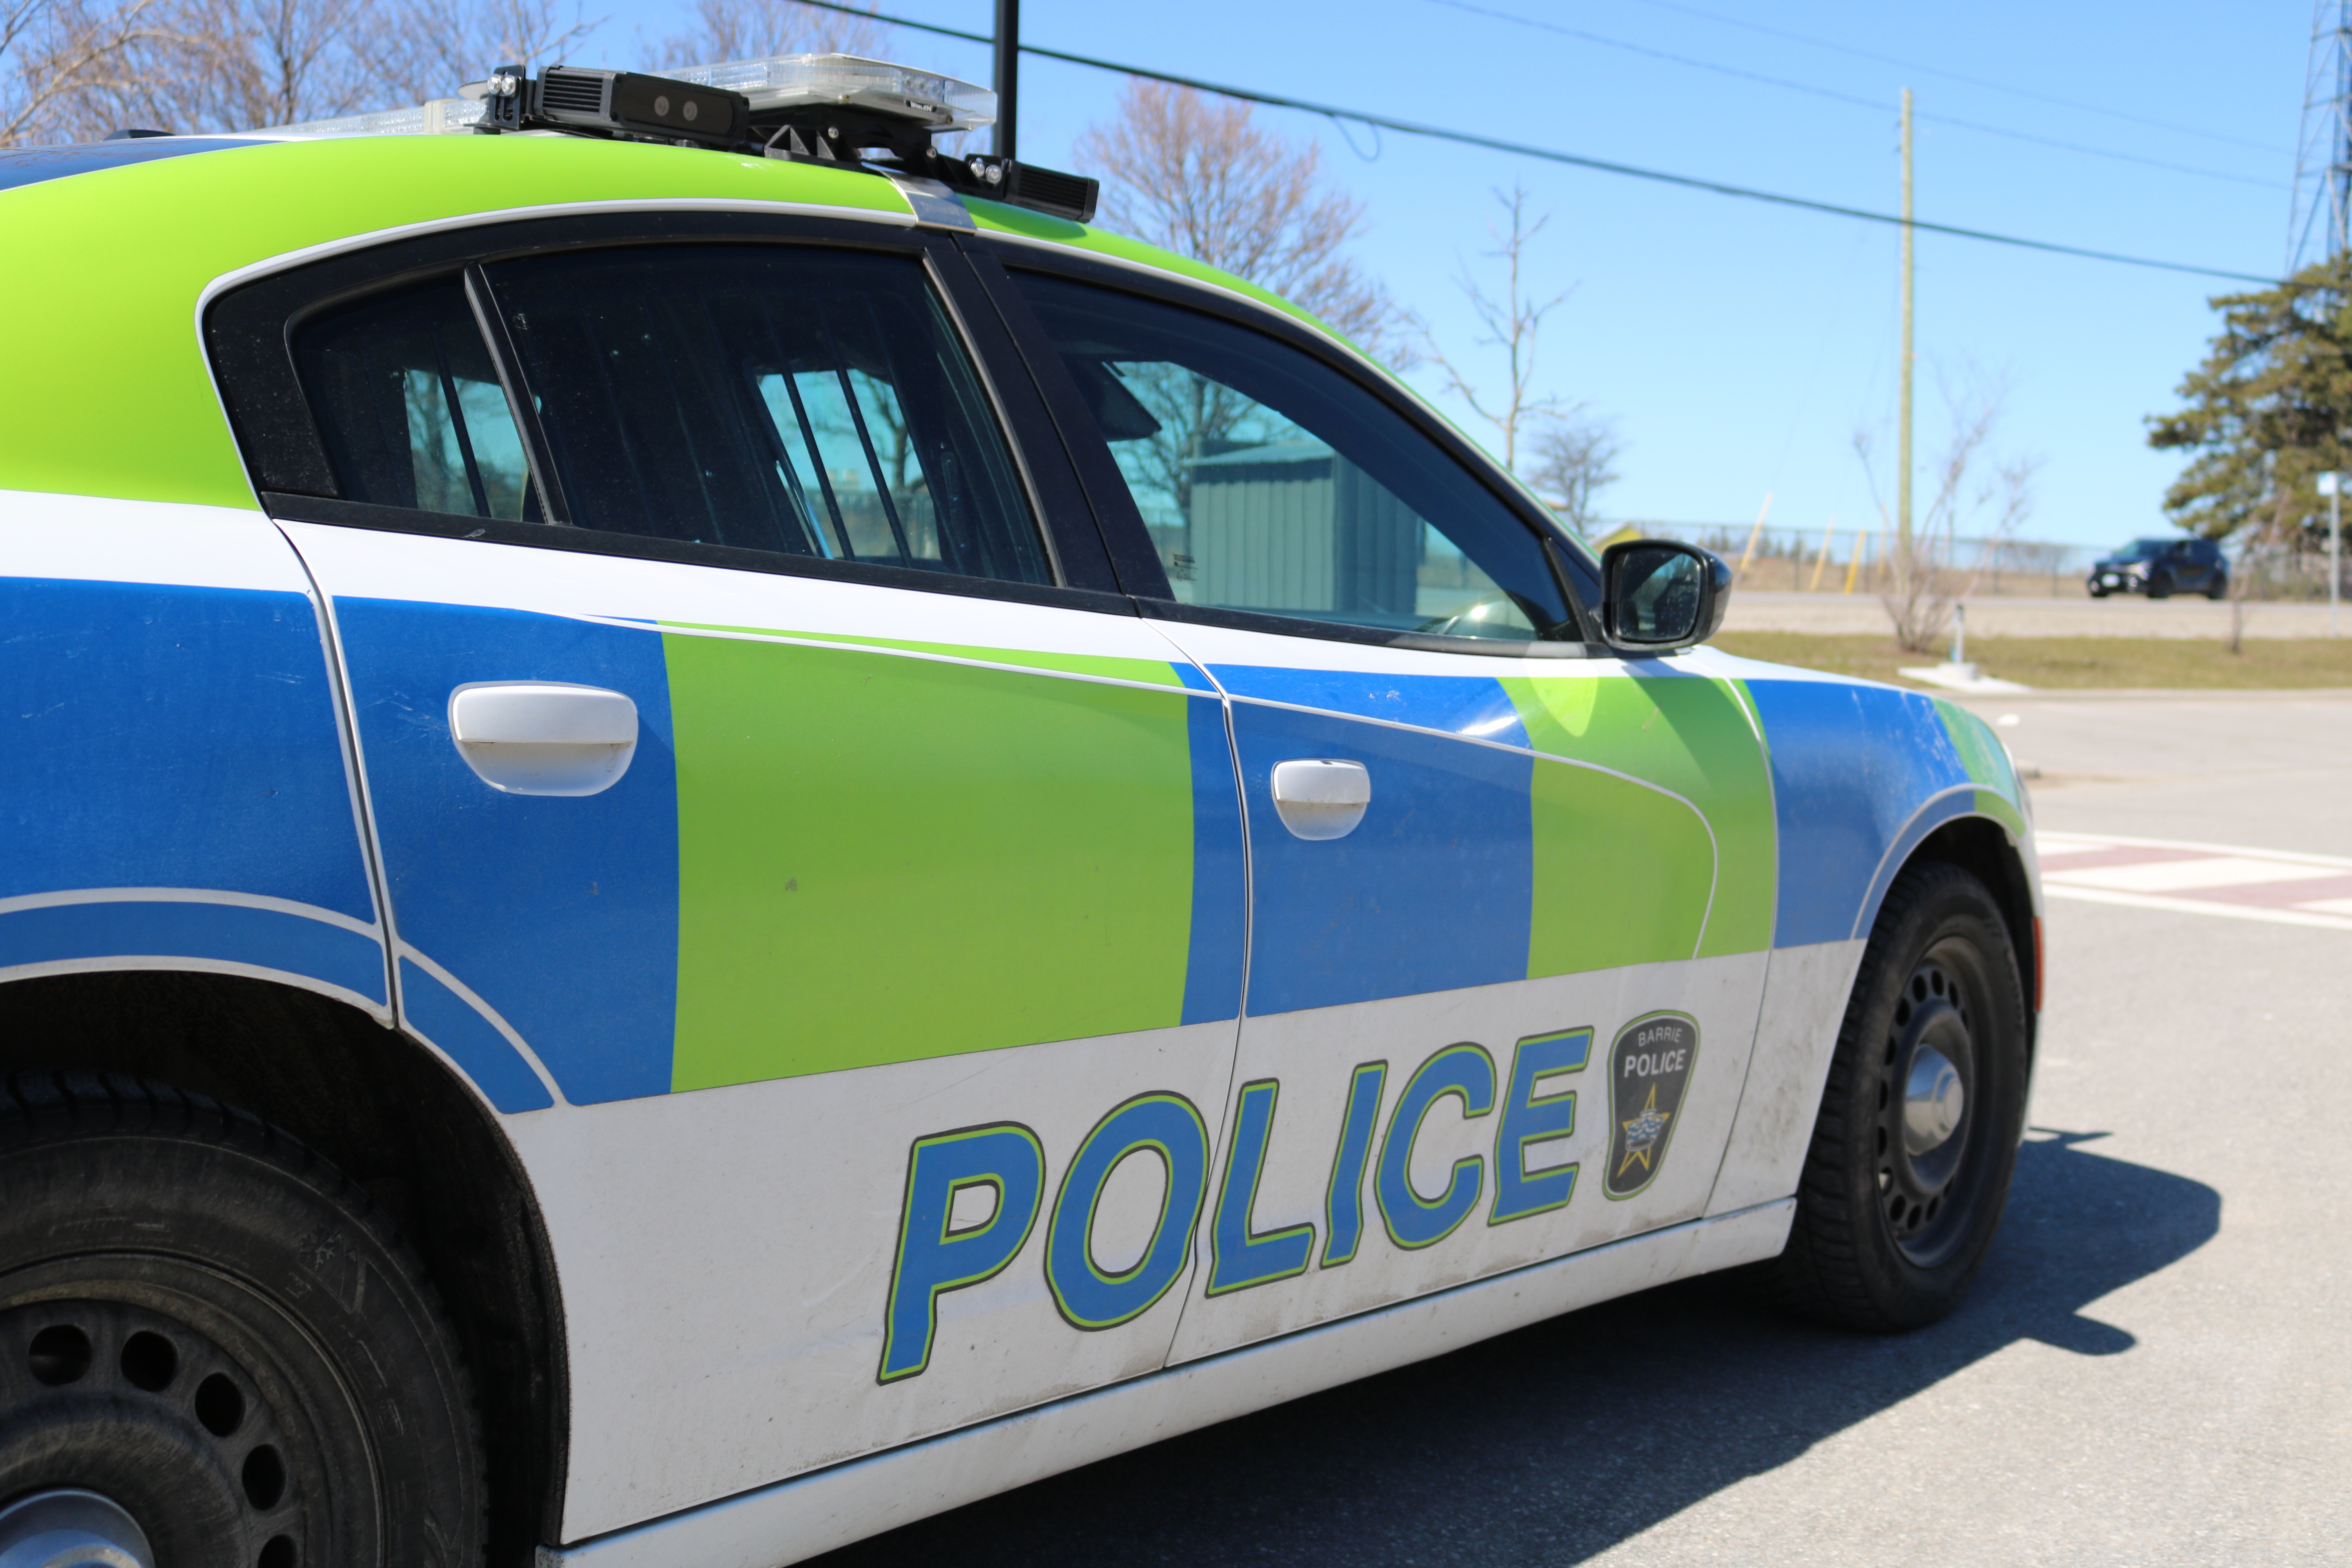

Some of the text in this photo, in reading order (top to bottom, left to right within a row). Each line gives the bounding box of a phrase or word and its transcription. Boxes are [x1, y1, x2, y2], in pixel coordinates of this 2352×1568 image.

[910, 101, 932, 112] WHELEN
[1638, 1026, 1682, 1047] BARRIE
[1624, 1049, 1686, 1078] POLICE
[876, 1026, 1594, 1386] POLICE
